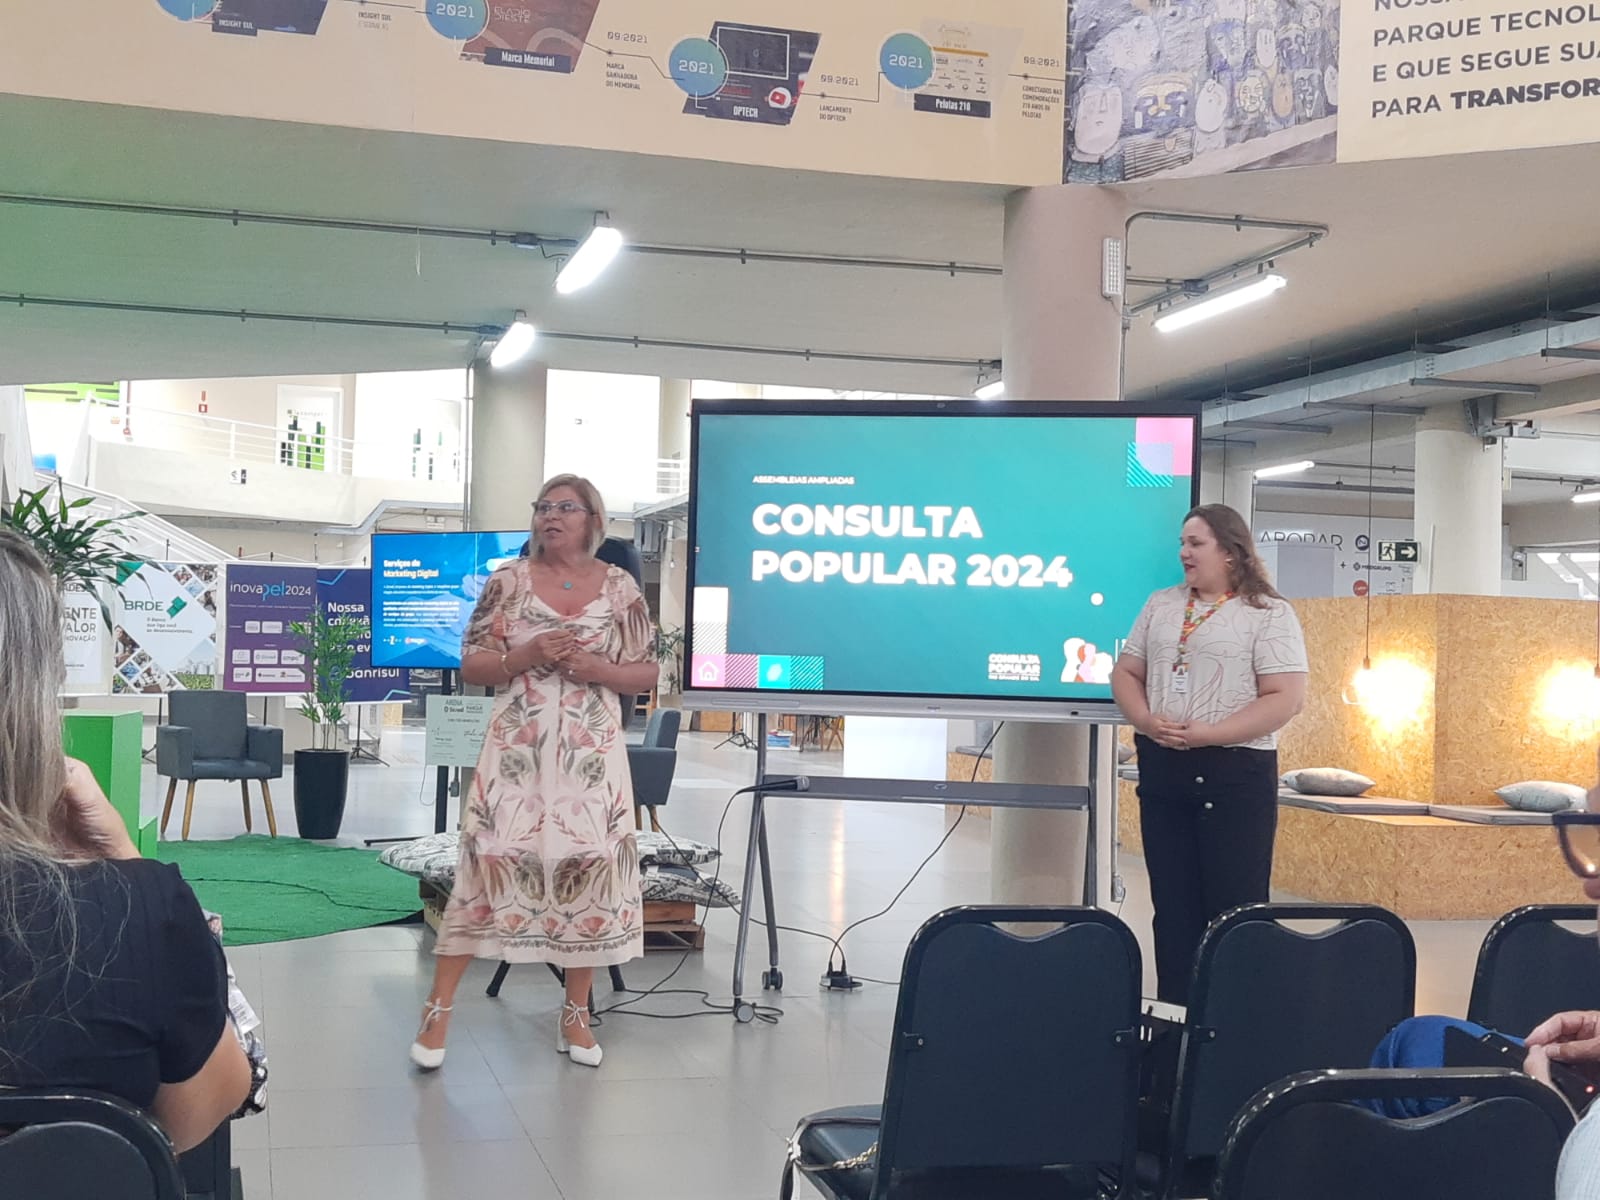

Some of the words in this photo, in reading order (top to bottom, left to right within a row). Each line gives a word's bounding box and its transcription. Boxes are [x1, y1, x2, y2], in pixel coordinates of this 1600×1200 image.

[436, 3, 475, 18] 2021
[1373, 17, 1482, 47] PARQUE
[1491, 3, 1600, 33] TECNOL
[501, 51, 523, 64] Marca
[523, 53, 555, 67] Memorial
[679, 59, 714, 74] 2021
[889, 54, 923, 69] 2021
[1373, 64, 1387, 82] E
[1396, 56, 1451, 80] QUE
[1460, 46, 1550, 73] SEGUE
[1560, 41, 1600, 62] SU
[935, 98, 958, 110] Pelotas
[959, 100, 971, 112] 210
[1372, 94, 1442, 119] PARA
[1450, 77, 1600, 110] TRANSFOR
[733, 105, 759, 118] OPTECH
[752, 503, 983, 538] CONSULTA
[752, 549, 957, 585] POPULAR
[965, 553, 1074, 588] 2024
[124, 600, 164, 611] BRDE
[327, 602, 365, 613] Nossa
[988, 653, 1041, 664] CONSULTA
[988, 663, 1041, 674] POPULAR
